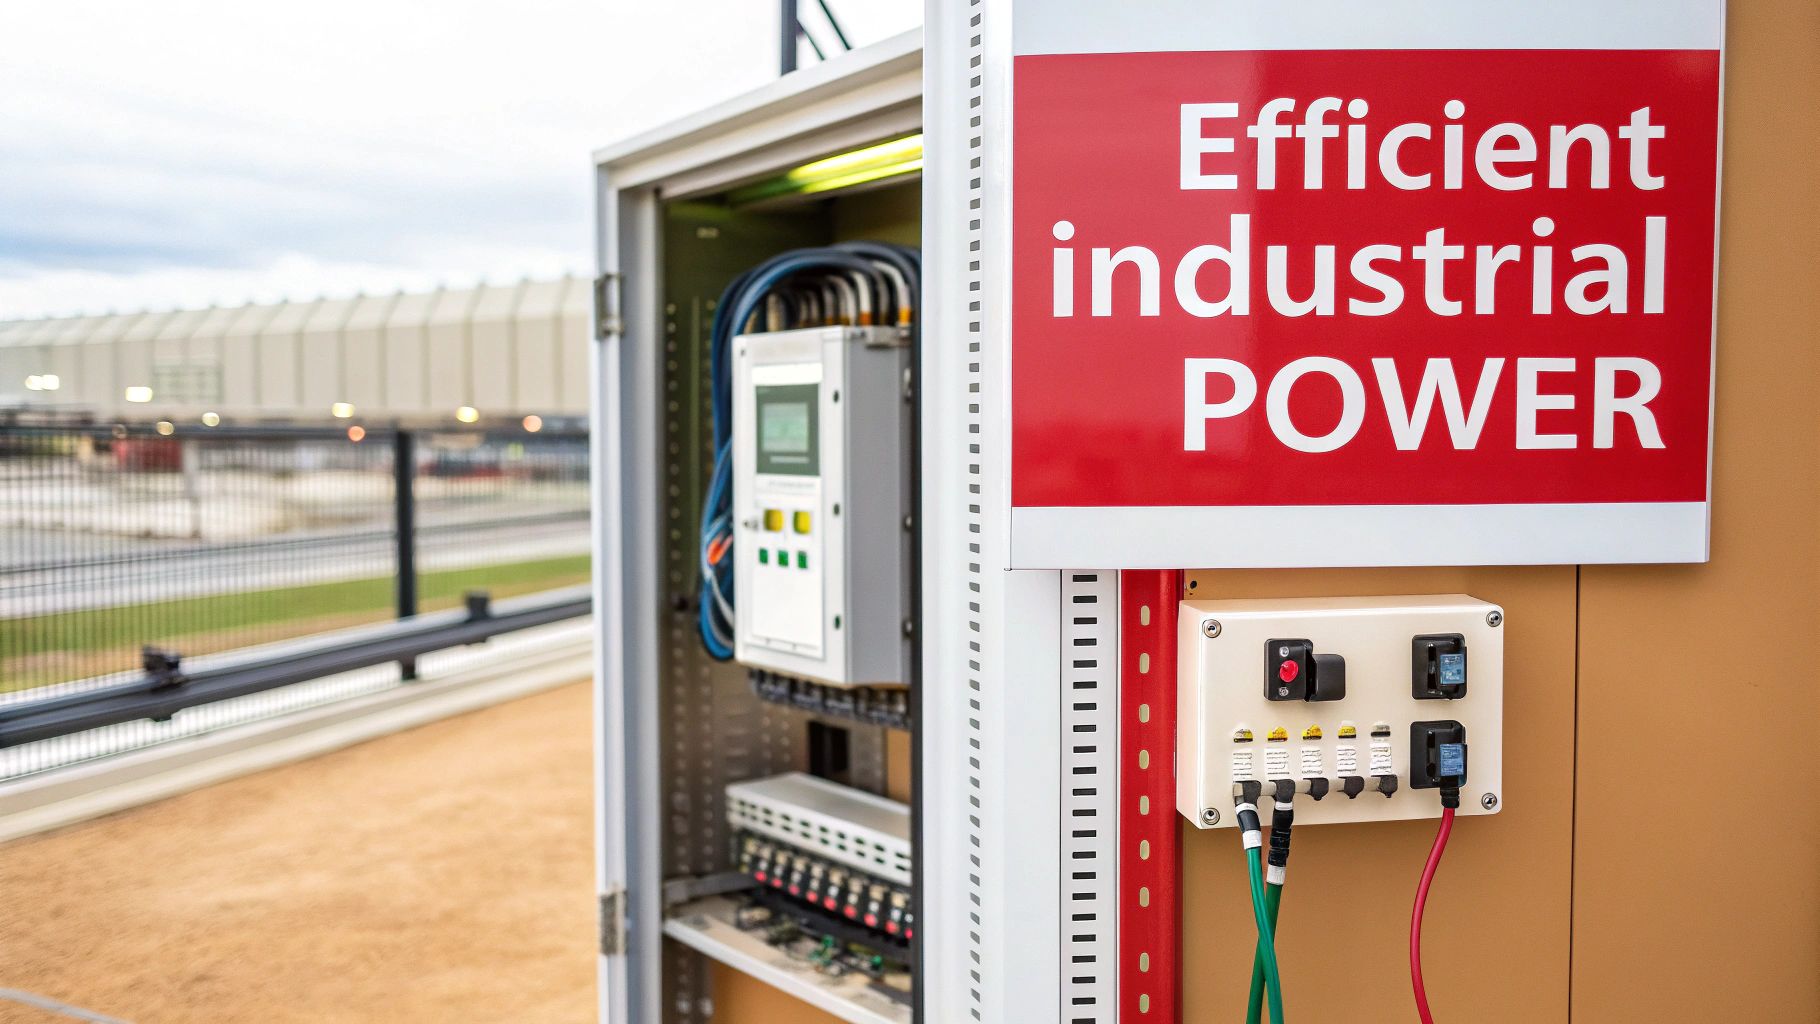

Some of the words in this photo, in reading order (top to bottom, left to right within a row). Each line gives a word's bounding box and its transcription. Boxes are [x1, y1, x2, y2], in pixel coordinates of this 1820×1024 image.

[1179, 96, 1666, 191] Efficient
[1052, 213, 1667, 318] industrial
[1183, 356, 1666, 453] POWER
